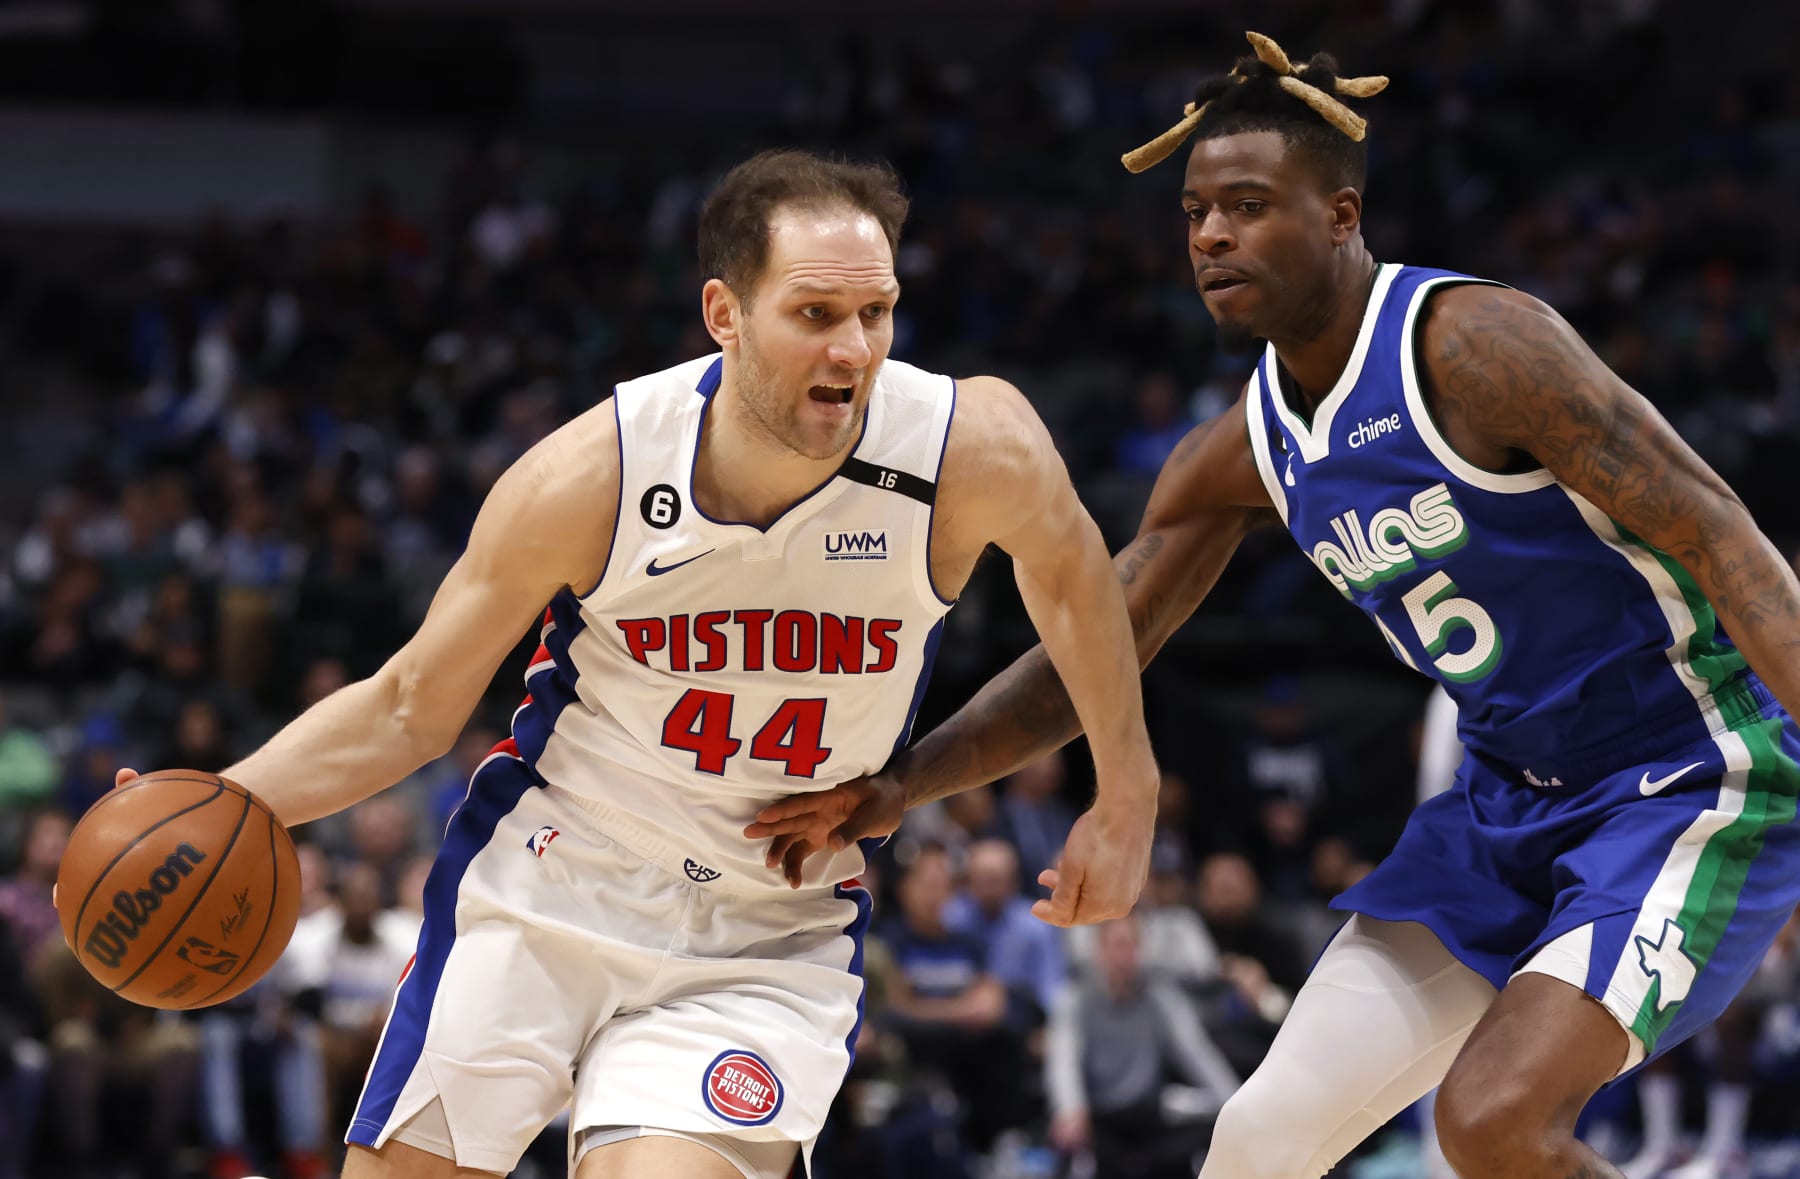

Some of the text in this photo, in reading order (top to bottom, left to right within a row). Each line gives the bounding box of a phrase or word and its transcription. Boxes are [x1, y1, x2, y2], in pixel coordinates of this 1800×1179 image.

[1348, 413, 1401, 448] chime
[877, 470, 897, 488] 16
[650, 491, 674, 524] 6
[825, 531, 887, 553] UWM
[1303, 482, 1469, 601] allas
[616, 609, 902, 674] PISTONS
[1374, 569, 1503, 684] 5
[661, 688, 832, 778] 44
[84, 841, 207, 969] Wilson
[717, 1078, 765, 1110] PISTONS
[724, 1066, 770, 1098] DETROIT
